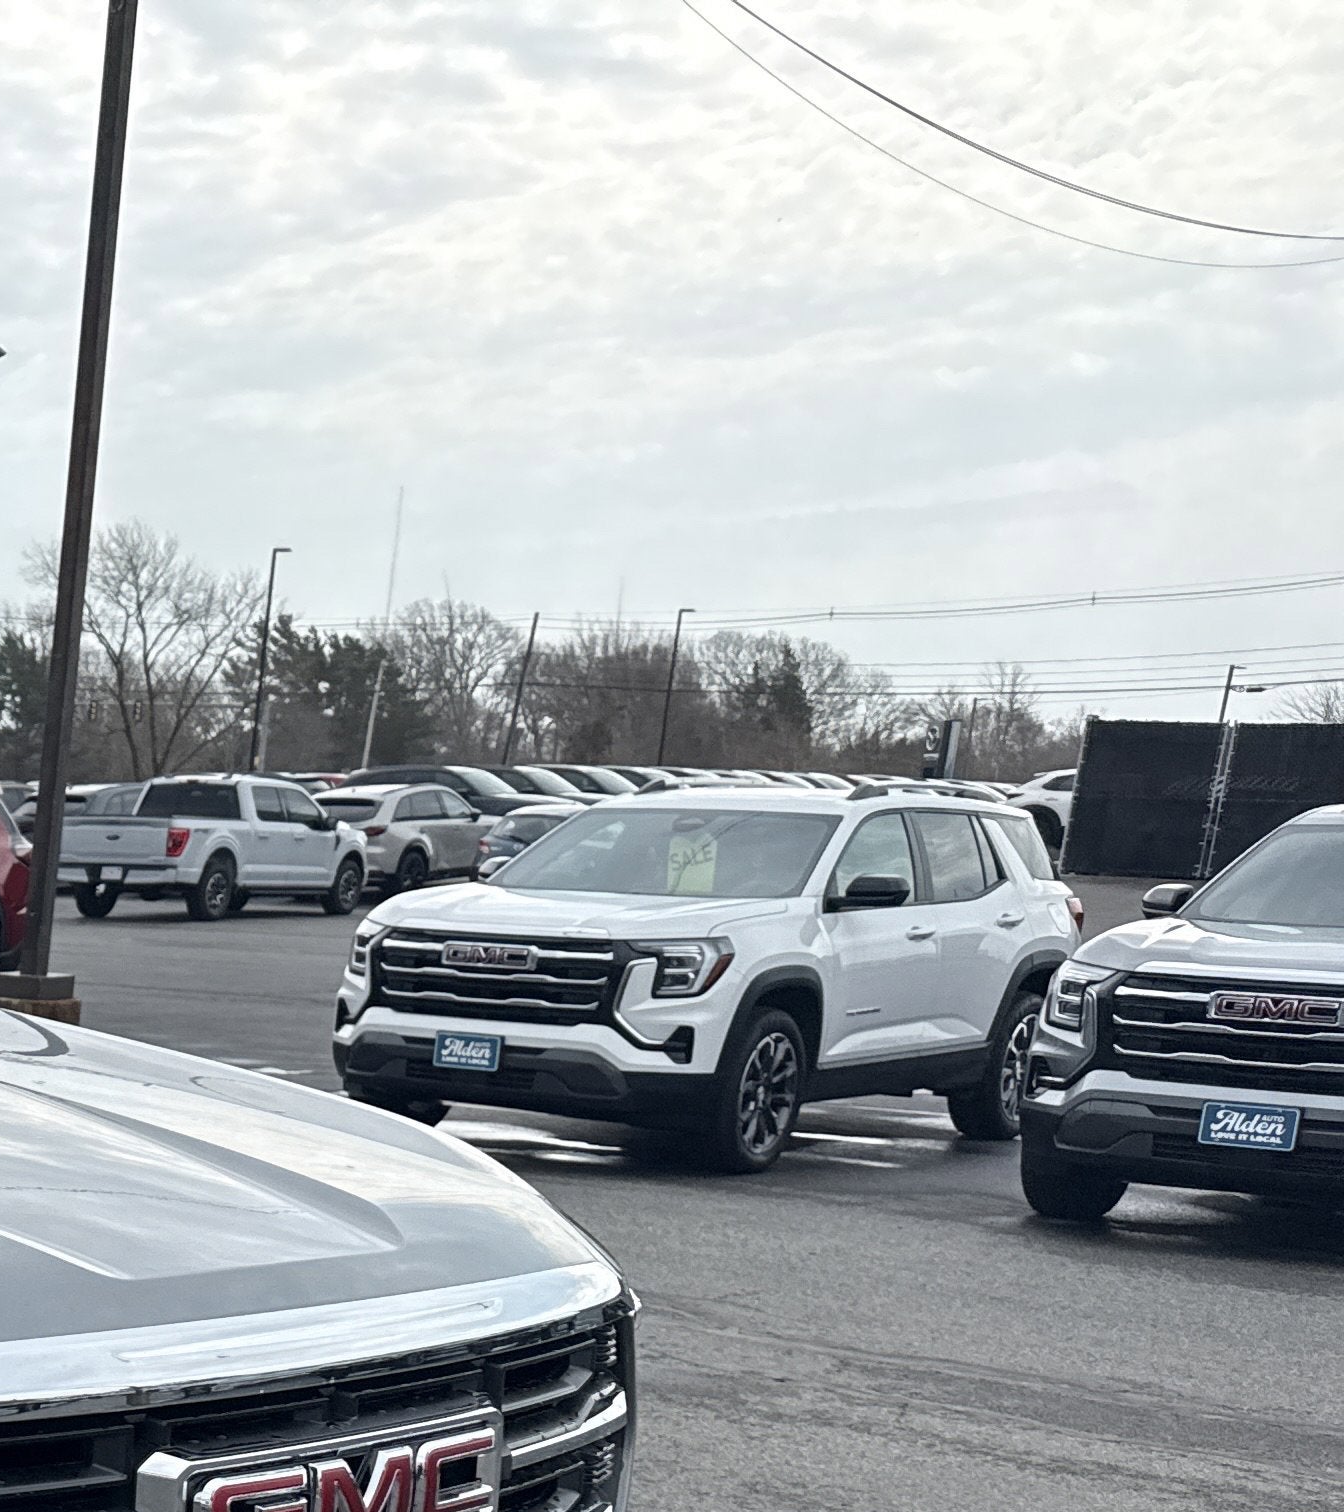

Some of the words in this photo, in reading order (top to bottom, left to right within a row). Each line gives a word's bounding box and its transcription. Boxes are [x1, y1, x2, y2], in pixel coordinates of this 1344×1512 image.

[446, 944, 528, 967] GMC
[1215, 995, 1339, 1022] GMC
[441, 1037, 491, 1059] Alden
[1210, 1109, 1286, 1135] Alden
